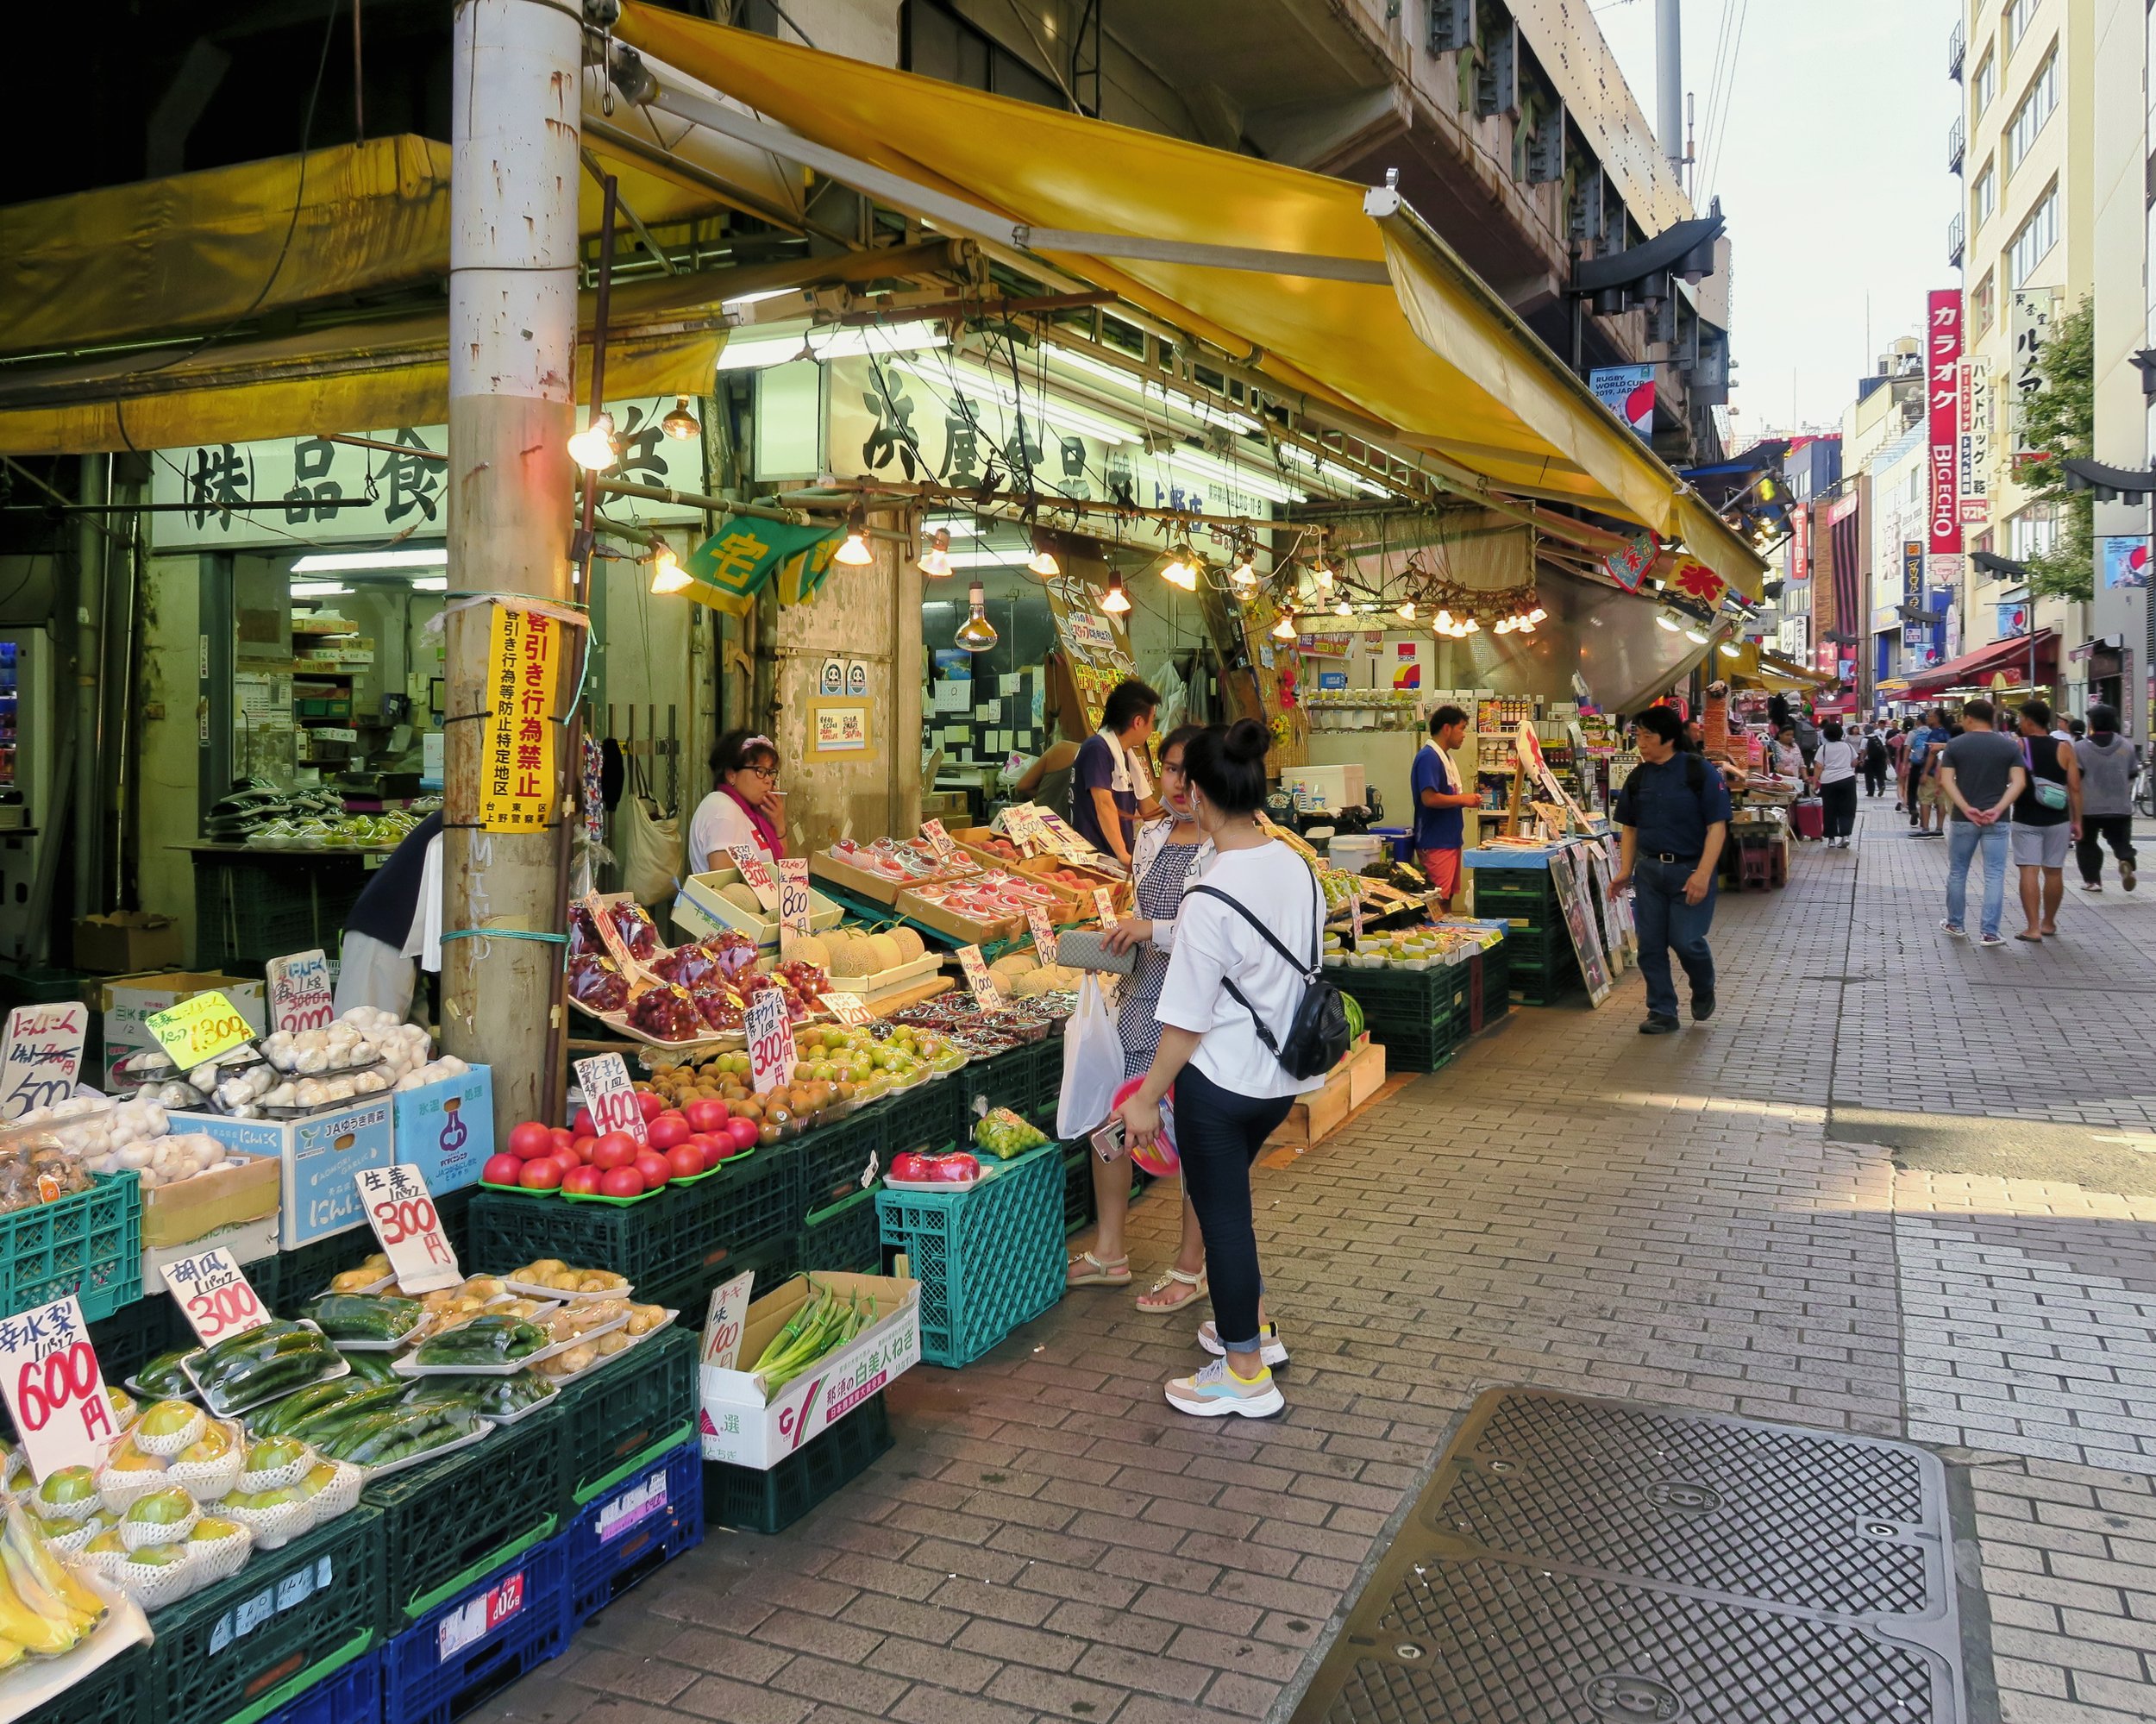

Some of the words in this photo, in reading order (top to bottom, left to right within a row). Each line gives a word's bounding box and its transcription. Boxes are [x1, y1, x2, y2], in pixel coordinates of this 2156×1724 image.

[1932, 307, 1957, 410] カラオケ
[1595, 374, 1625, 383] RUGBY
[1595, 381, 1626, 390] WORLD
[1595, 388, 1615, 398] 2019,
[1616, 386, 1645, 396] JAPAN
[1932, 444, 1953, 481] BIG
[1932, 484, 1953, 538] ECHO
[1793, 519, 1805, 574] GAME
[1908, 559, 1921, 612] マツモトキ
[492, 609, 521, 796] 客引き行為等防止特定地区
[515, 608, 551, 799] 客引き行為禁止
[484, 812, 546, 824] 上野警察署
[782, 885, 808, 918] 800
[13, 1009, 79, 1039] にんにく
[755, 1000, 774, 1025] キウイ
[835, 1006, 874, 1025] 1200
[592, 1056, 624, 1081] とまと
[751, 1031, 782, 1077] 300
[774, 1063, 786, 1086] 円
[2, 1070, 72, 1119] 500
[325, 1108, 386, 1138] JAゆうき青森
[594, 1089, 641, 1134] 400
[239, 1127, 278, 1148] にんにく
[319, 1156, 352, 1182] AOMORI
[341, 1152, 370, 1175] GARLIC
[363, 1168, 410, 1192] 生姜
[310, 1194, 363, 1228] にんに
[373, 1197, 436, 1245] 300
[423, 1232, 451, 1265] 円
[166, 1251, 229, 1284] 胡瓜
[0, 1300, 78, 1351] 幸水梨
[186, 1281, 258, 1338] 300
[706, 1320, 739, 1361] 100
[16, 1341, 98, 1432] 600
[80, 1398, 113, 1442] 円
[723, 1413, 740, 1435] 選
[704, 1446, 737, 1462] とちぎ
